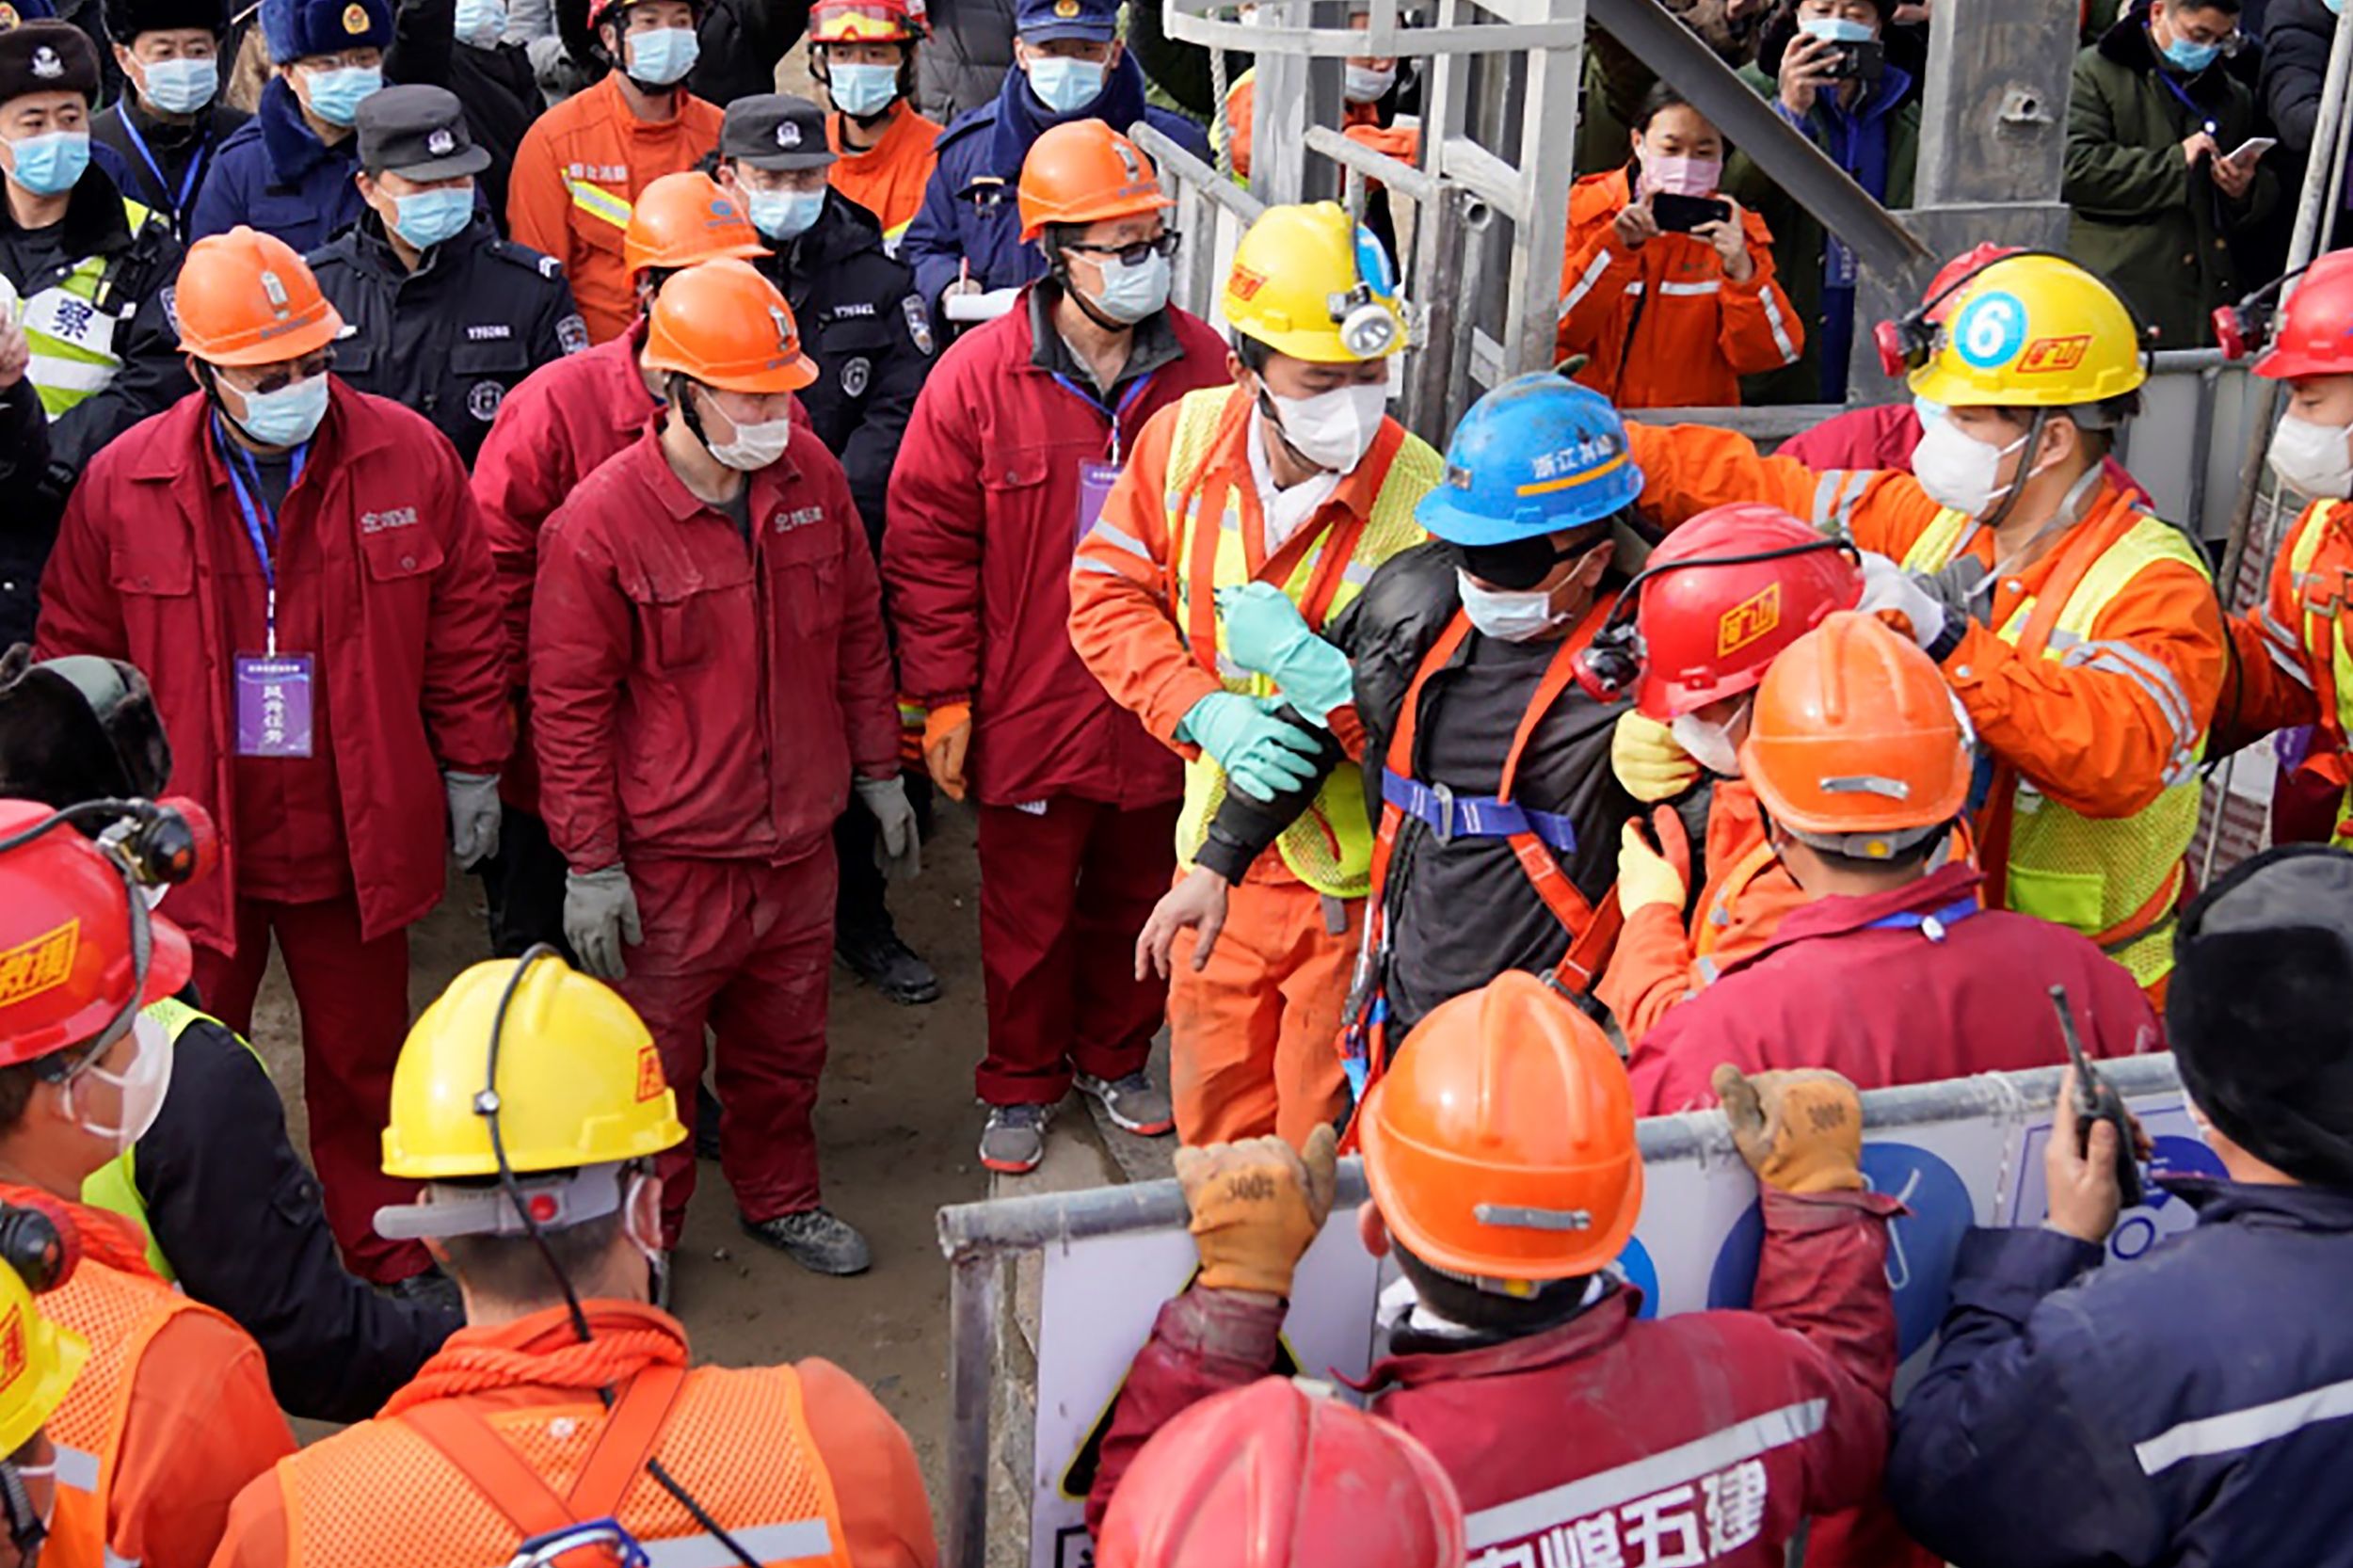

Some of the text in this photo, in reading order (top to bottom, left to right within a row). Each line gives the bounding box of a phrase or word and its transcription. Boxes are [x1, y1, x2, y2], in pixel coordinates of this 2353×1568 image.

[52, 297, 93, 340] 察
[1966, 299, 2012, 358] 6
[1465, 1459, 1767, 1568] 煤五建
